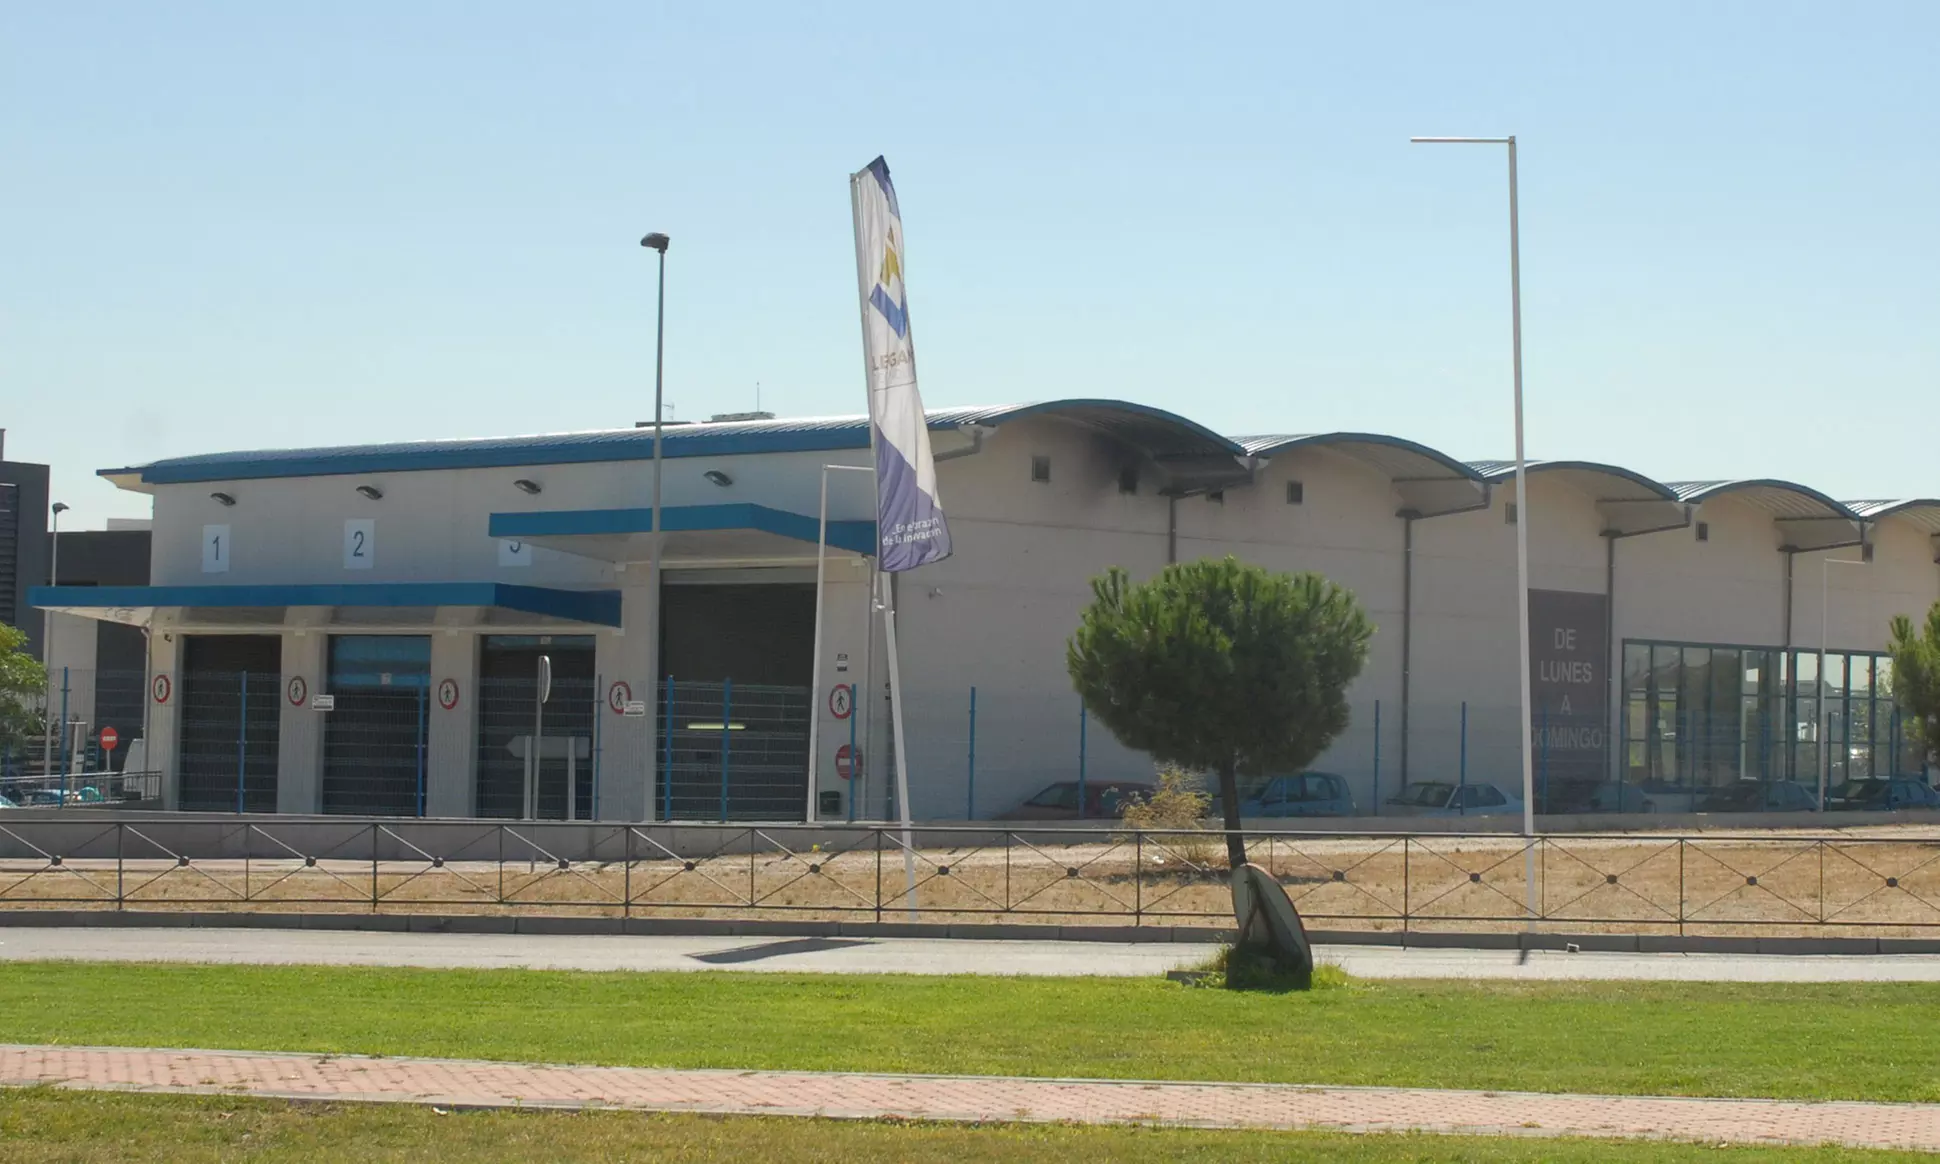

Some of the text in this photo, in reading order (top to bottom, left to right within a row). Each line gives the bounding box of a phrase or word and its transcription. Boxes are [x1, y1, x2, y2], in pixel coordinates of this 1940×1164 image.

[872, 349, 912, 371] LEGA
[212, 535, 220, 561] 1
[352, 530, 365, 557] 2
[1554, 628, 1576, 650] DE
[1540, 660, 1592, 683] LUNES
[1560, 694, 1572, 715] A
